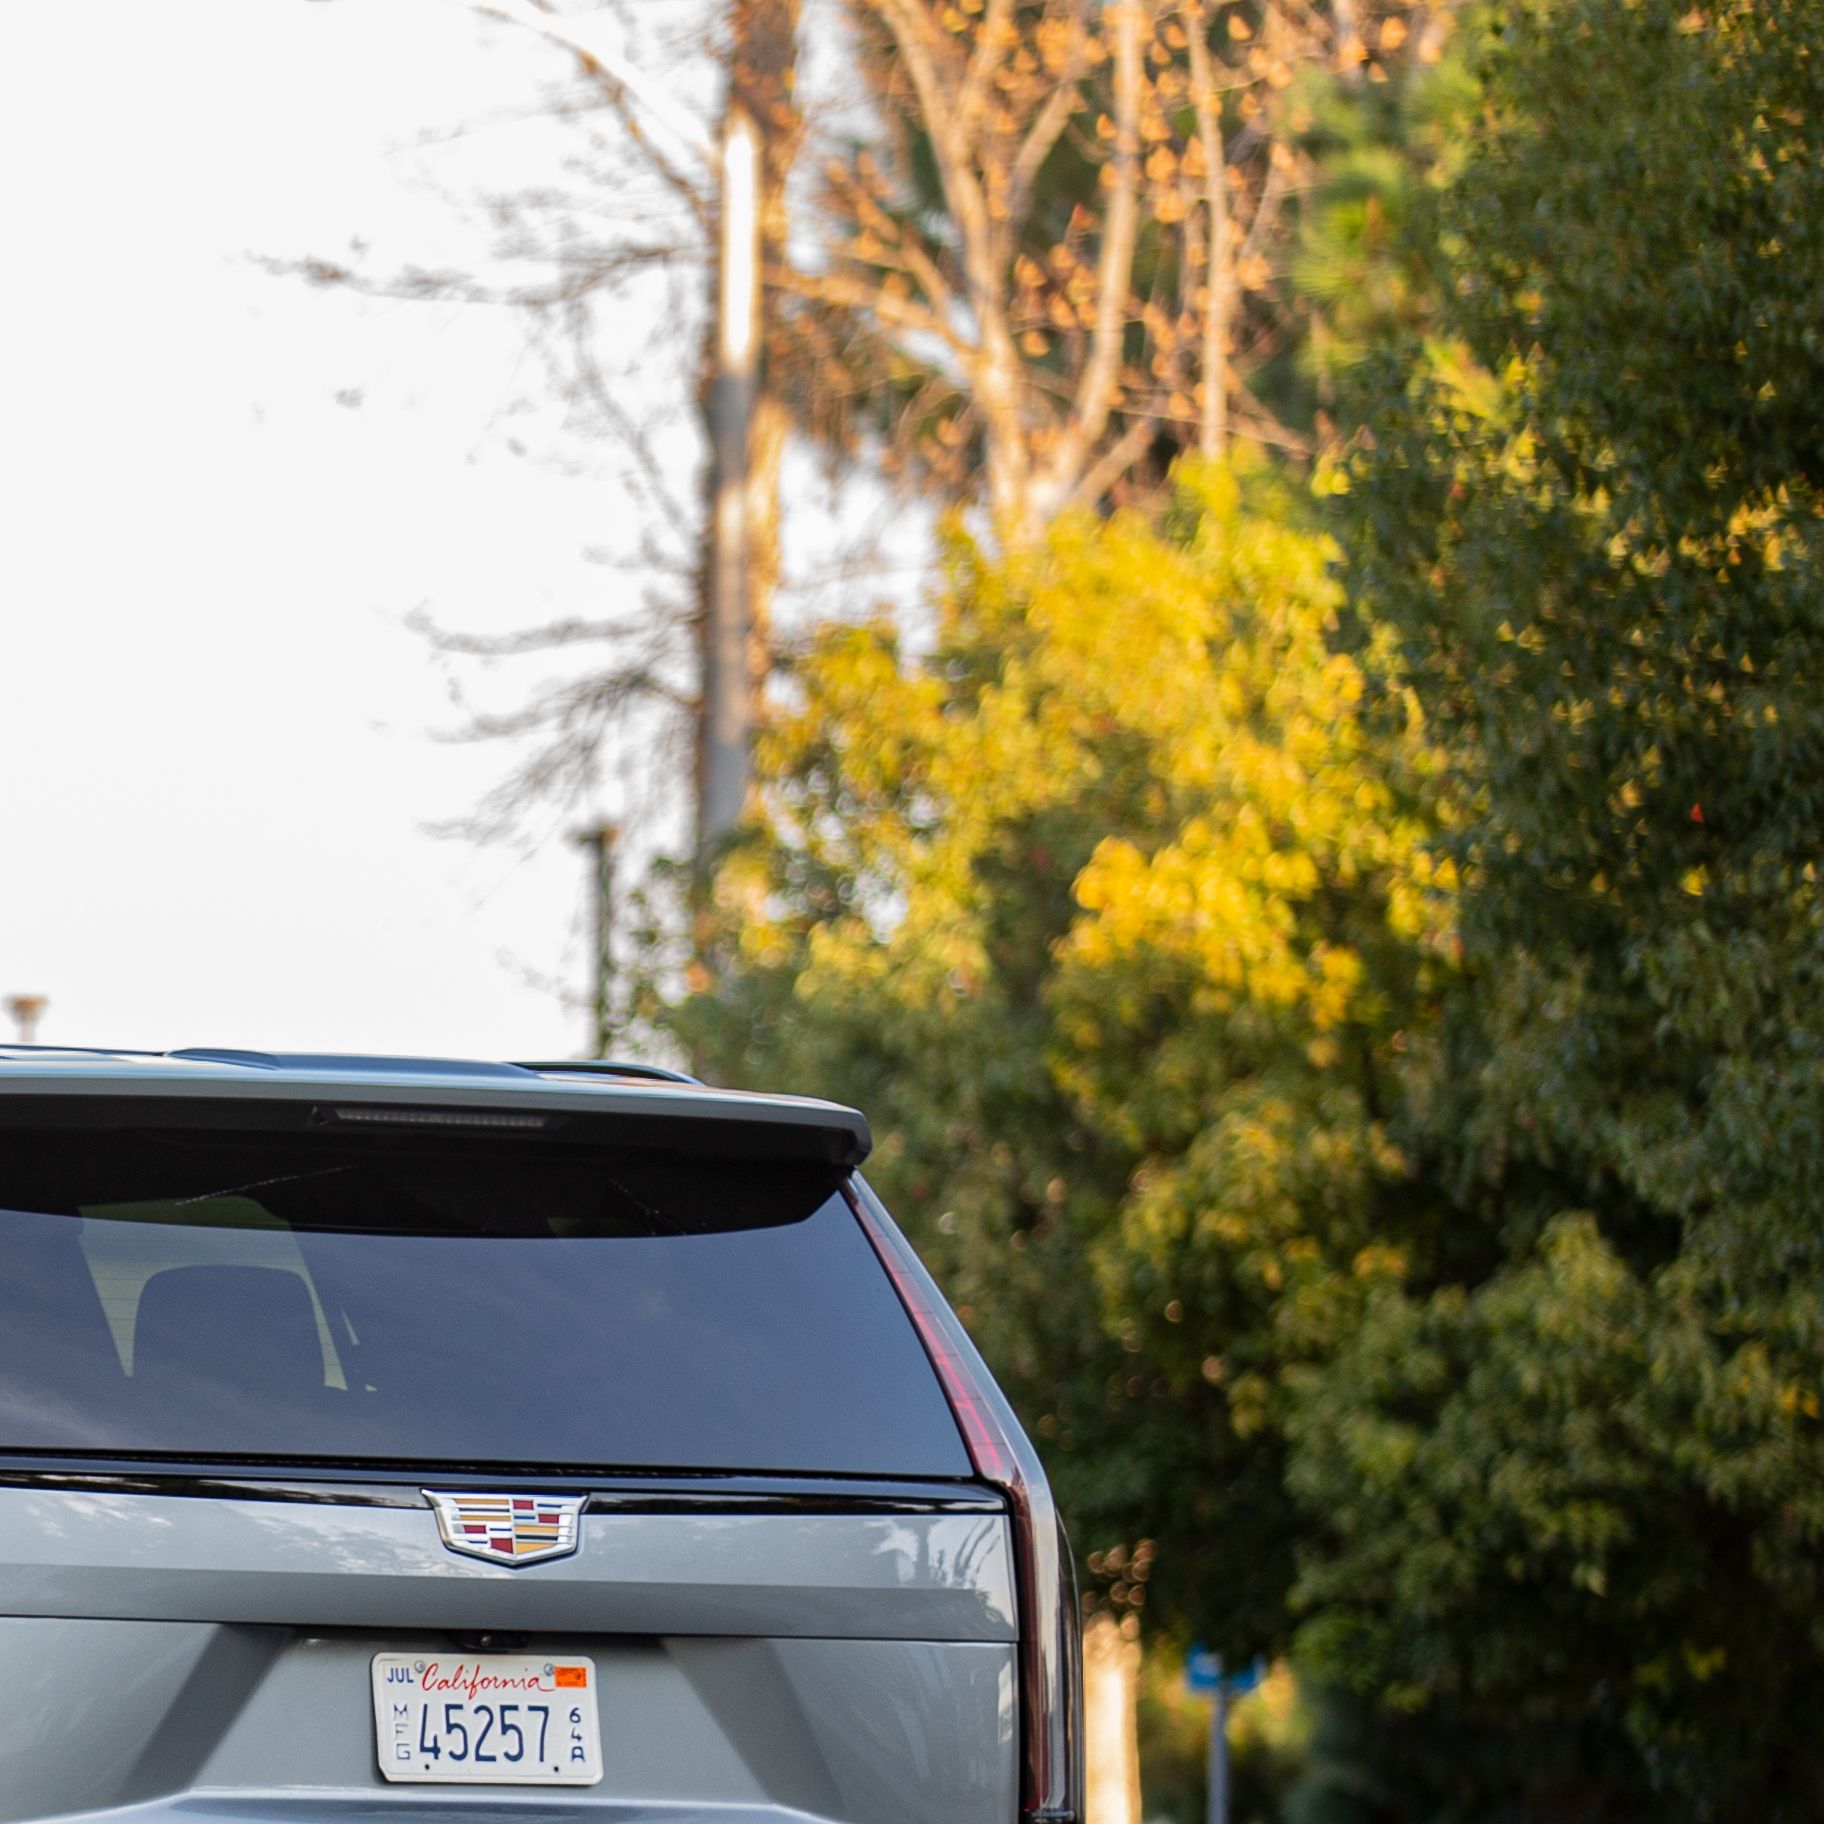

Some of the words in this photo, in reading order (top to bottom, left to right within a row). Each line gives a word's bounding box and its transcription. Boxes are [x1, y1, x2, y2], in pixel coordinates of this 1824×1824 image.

[387, 1667, 414, 1683] JUL
[421, 1663, 556, 1700] California
[419, 1703, 550, 1763] 45257
